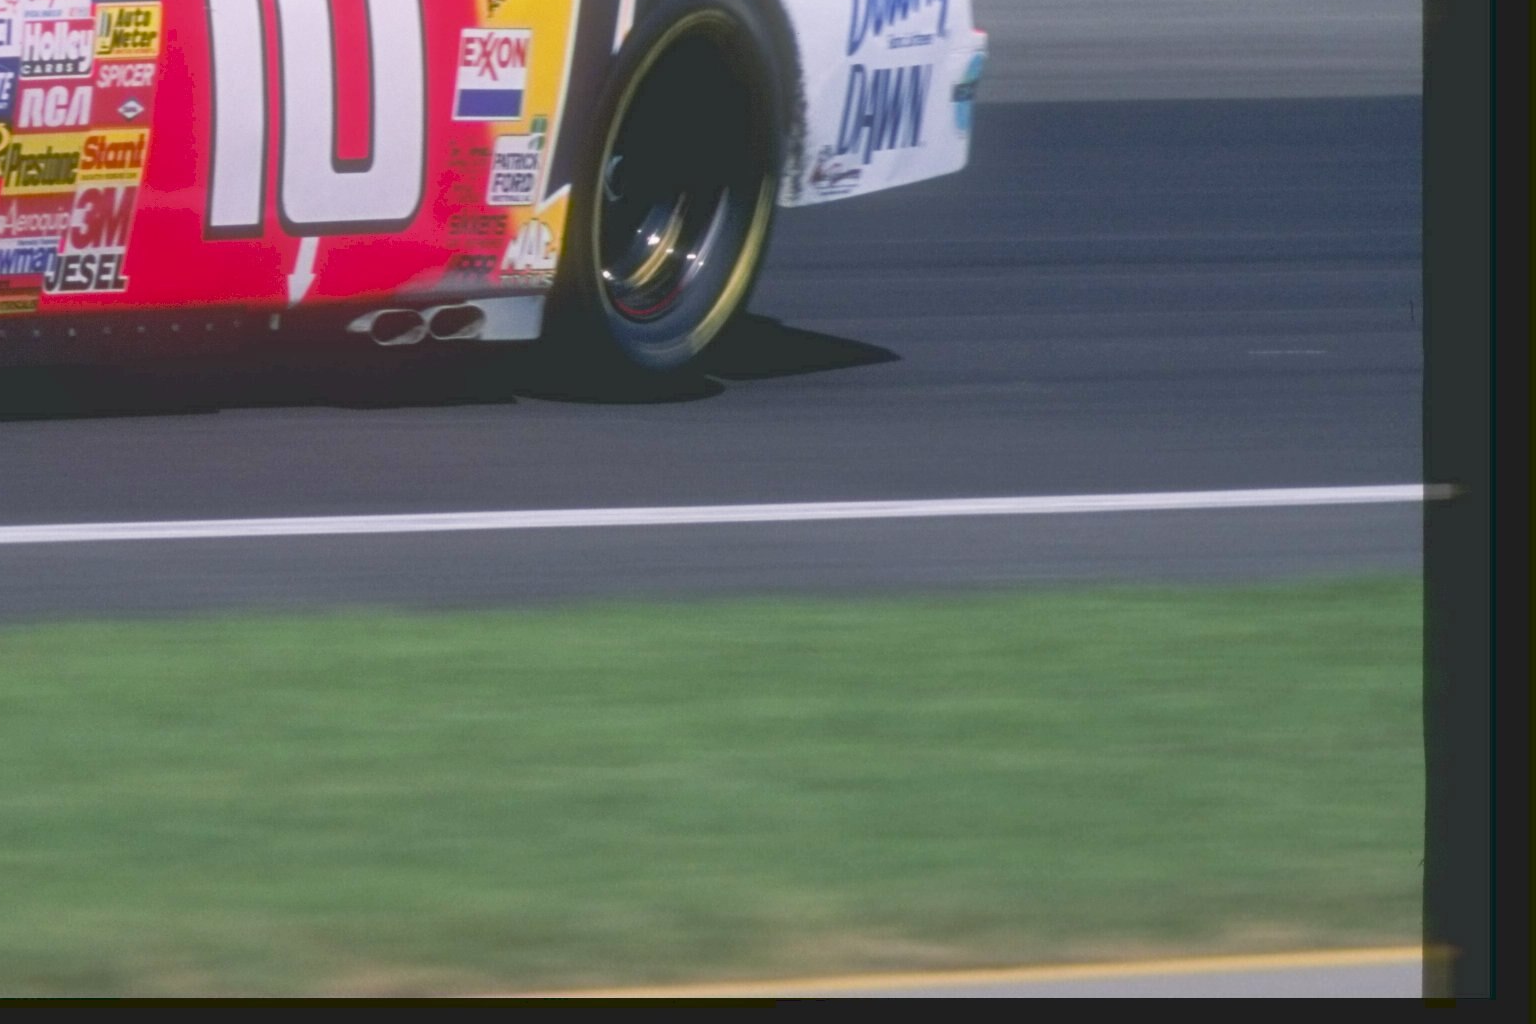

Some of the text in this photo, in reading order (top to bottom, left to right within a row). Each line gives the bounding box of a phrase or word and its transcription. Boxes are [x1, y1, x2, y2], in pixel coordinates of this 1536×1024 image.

[116, 9, 152, 28] Auto
[22, 21, 93, 73] Holley
[113, 28, 157, 48] Meter
[20, 63, 75, 75] CARBS
[461, 32, 530, 81] EXXON
[97, 63, 156, 88] SPICER
[18, 85, 93, 127] RCA
[80, 135, 145, 170] Stant
[492, 172, 534, 193] FORD
[71, 187, 140, 249] 3M
[44, 253, 126, 292] JESEL
